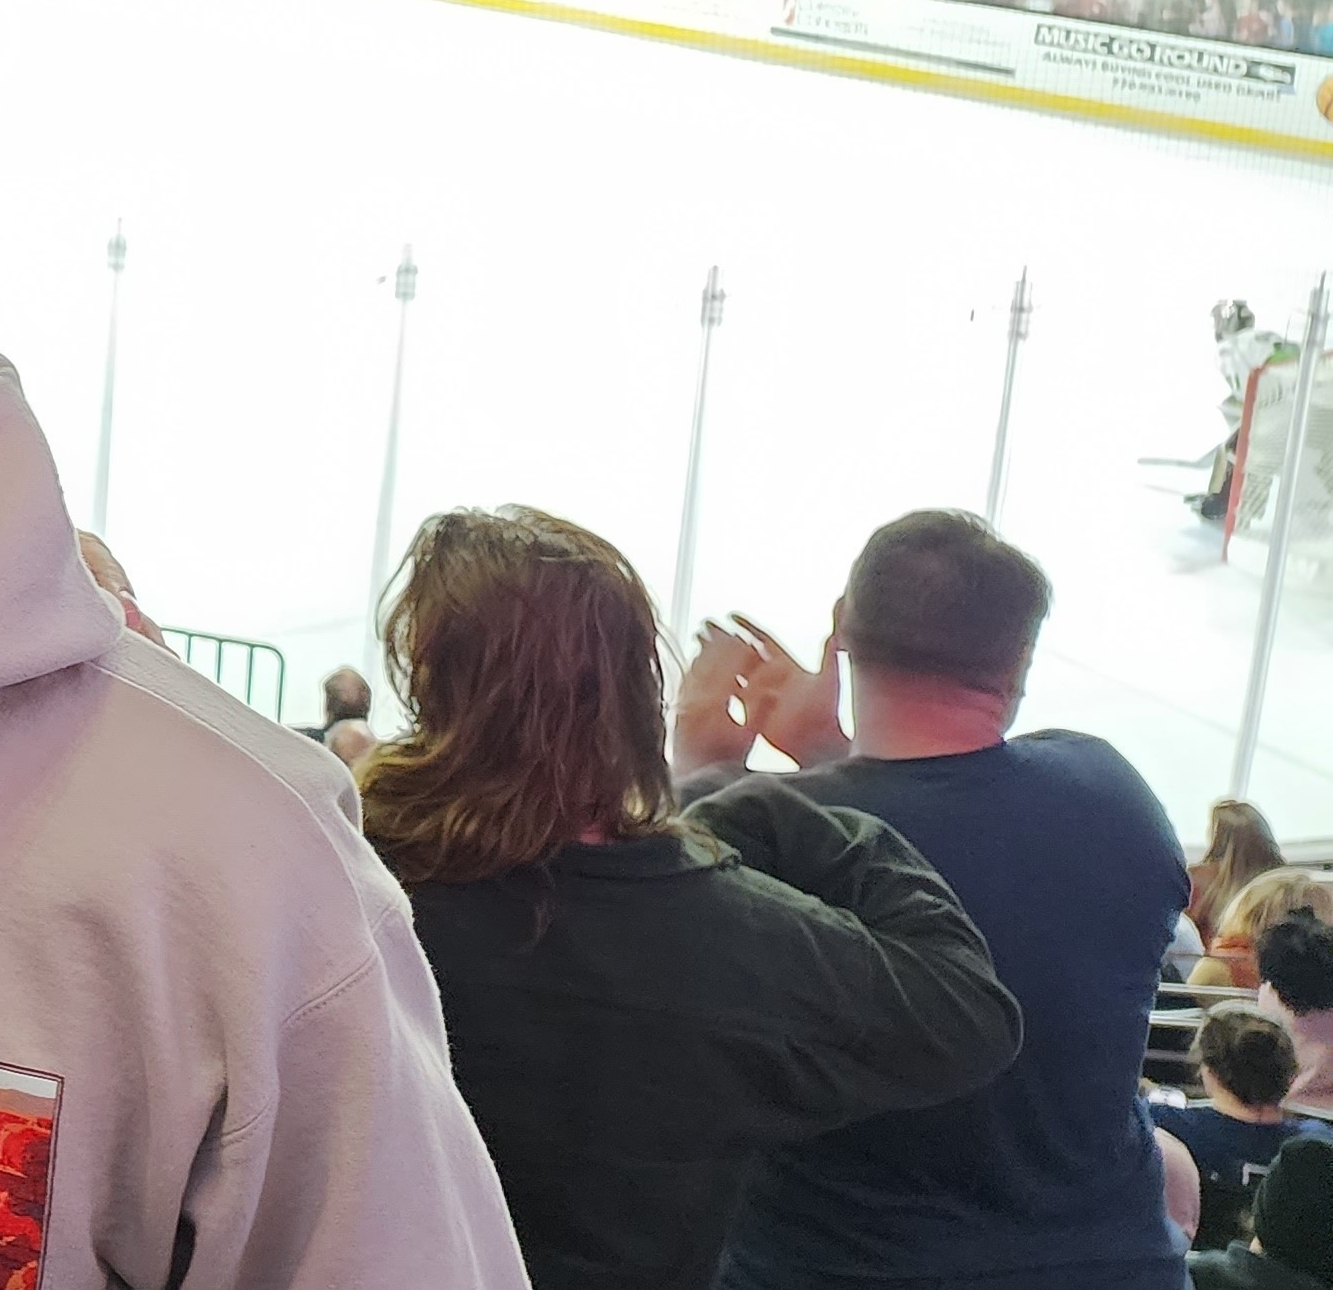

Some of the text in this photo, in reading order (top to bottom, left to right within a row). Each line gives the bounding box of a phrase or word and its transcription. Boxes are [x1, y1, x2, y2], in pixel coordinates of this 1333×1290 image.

[1036, 25, 1108, 54] MUSIC
[1112, 39, 1151, 60] GO
[1154, 45, 1247, 78] ROUND
